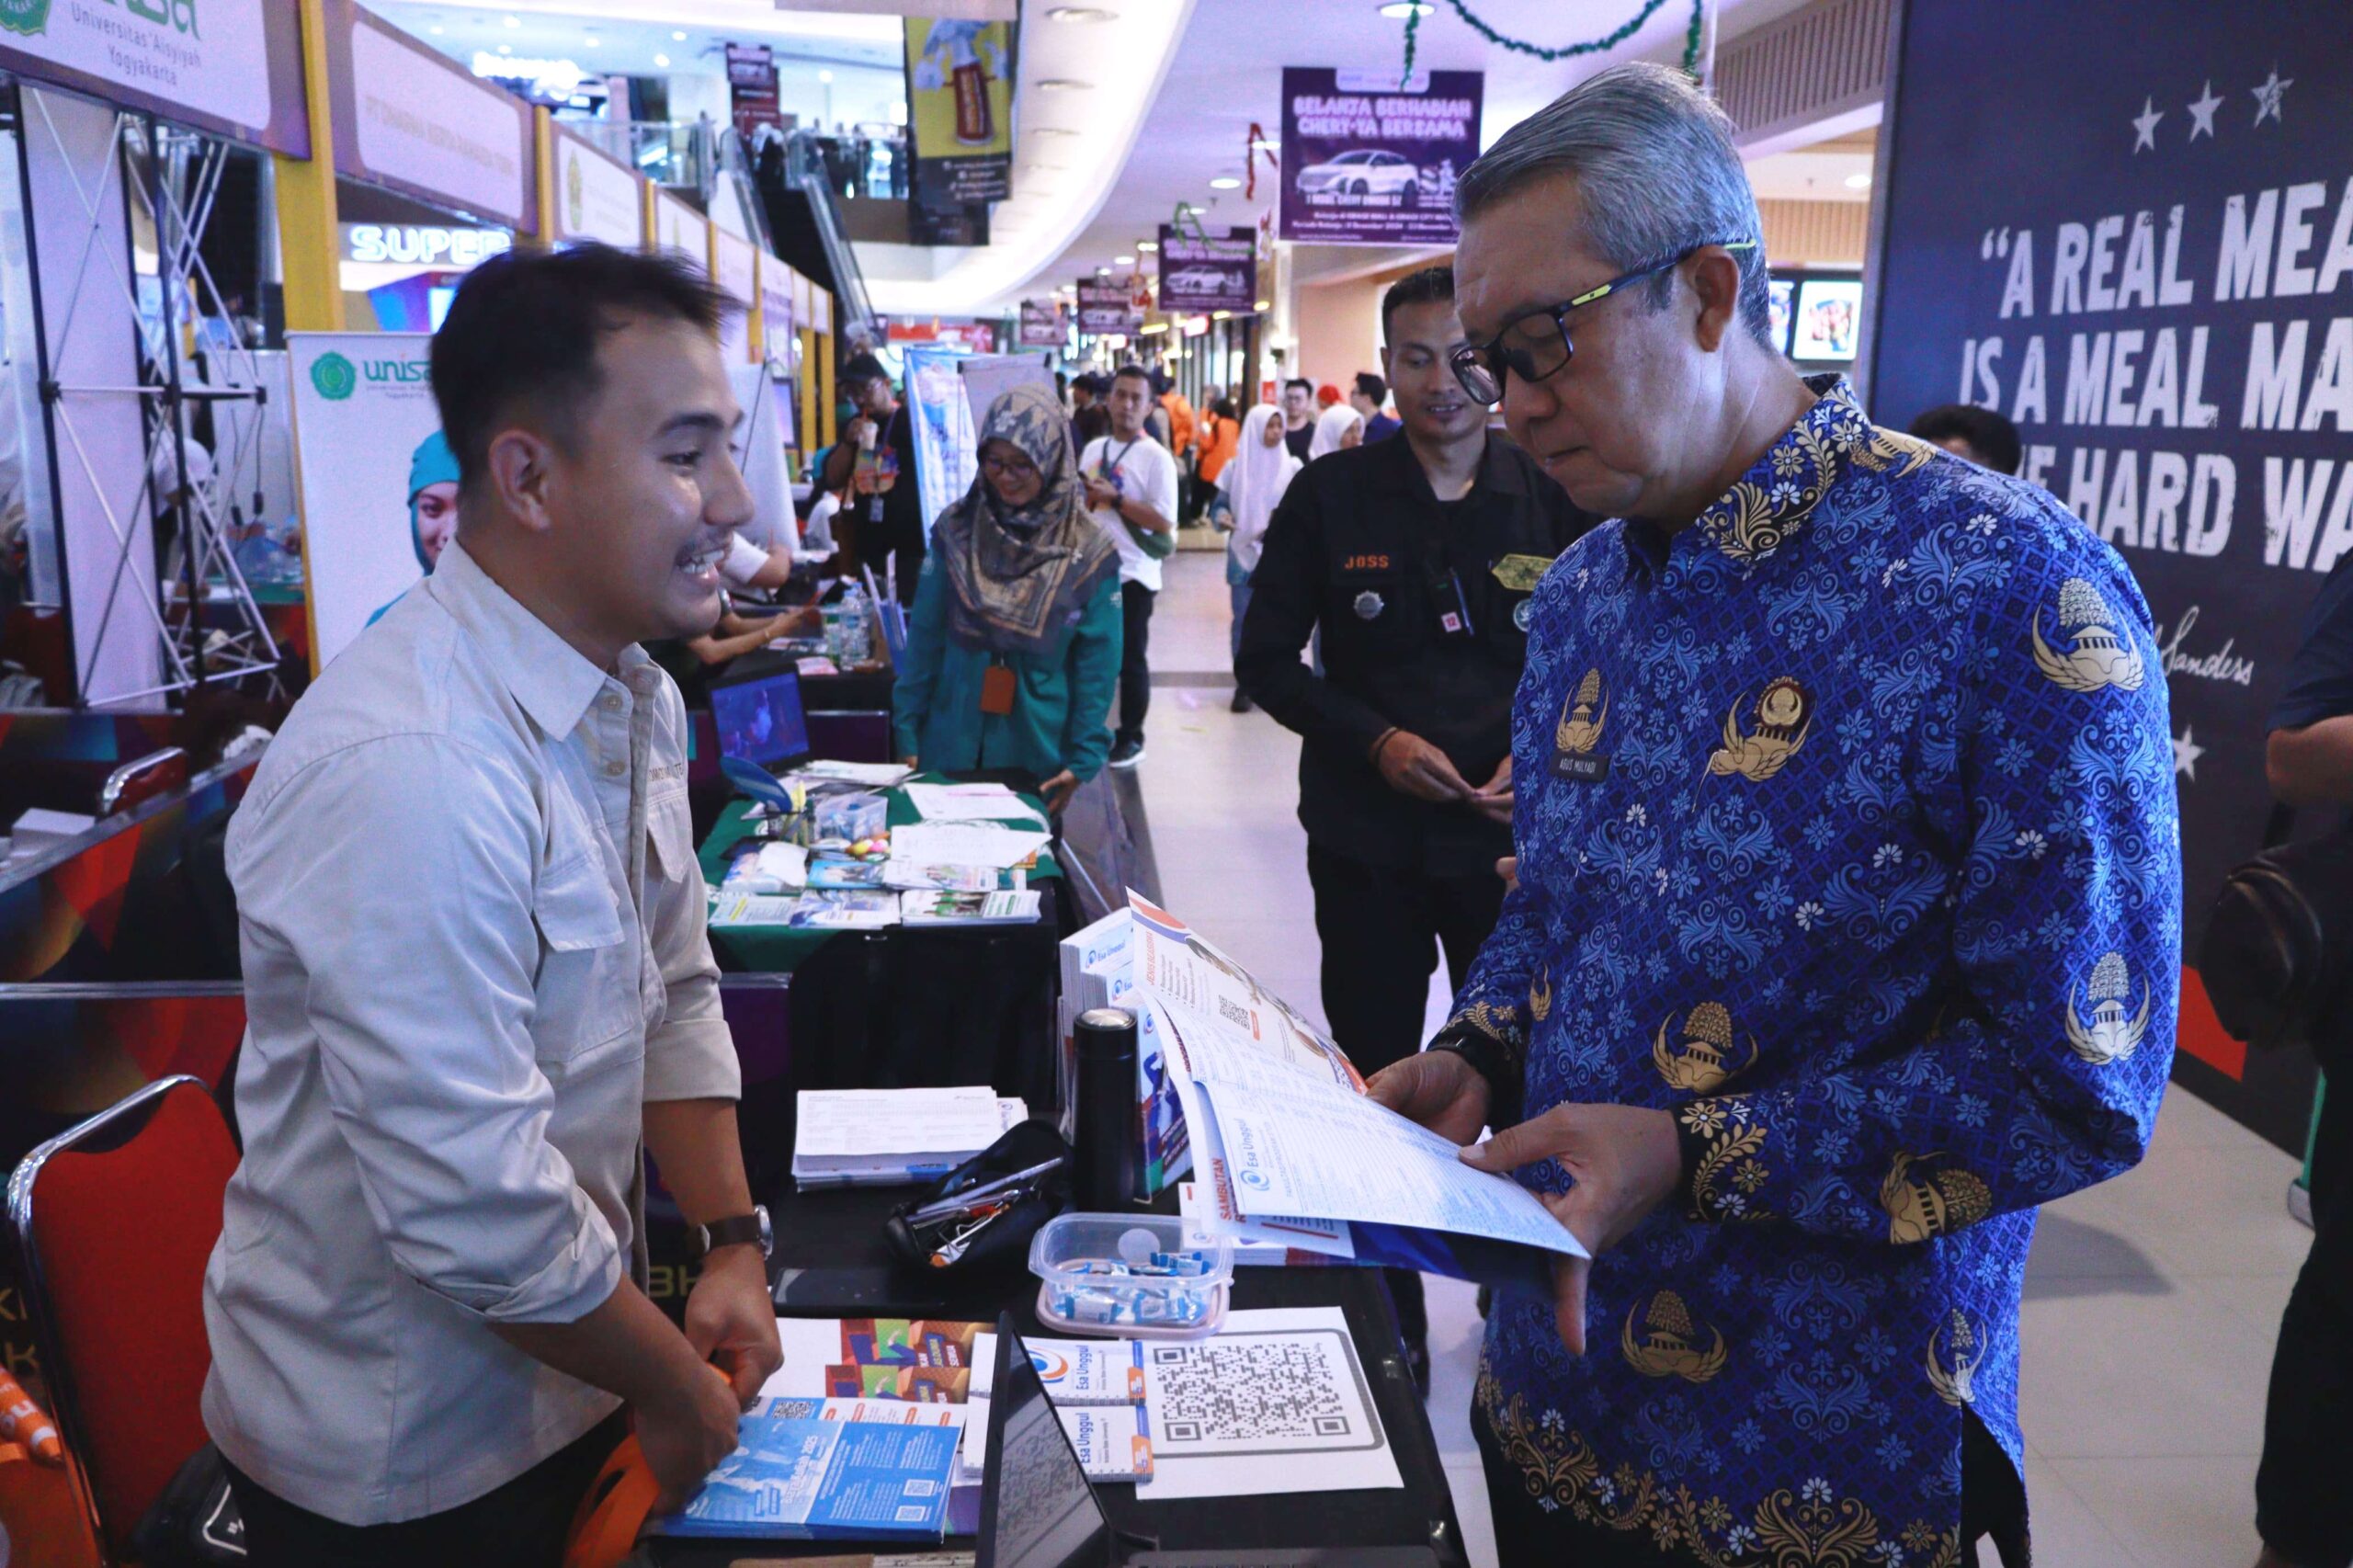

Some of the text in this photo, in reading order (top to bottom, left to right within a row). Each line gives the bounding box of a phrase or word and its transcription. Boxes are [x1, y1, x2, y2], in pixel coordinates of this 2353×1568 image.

[71, 1, 147, 48] Universitas
[108, 44, 177, 85] Yogyakarta
[2049, 204, 2194, 315] REAL
[1959, 336, 2004, 412] IS
[2011, 335, 2047, 425] A
[2062, 325, 2220, 429] MEAL
[2067, 448, 2236, 557] HARD
[1345, 554, 1389, 569] JOSS
[1233, 1117, 1259, 1167] Esa Unggul
[1211, 1157, 1232, 1221] SAMBUTAN
[1075, 1345, 1092, 1391] Esa Unggul
[1075, 1413, 1094, 1464] Esa Unggul
